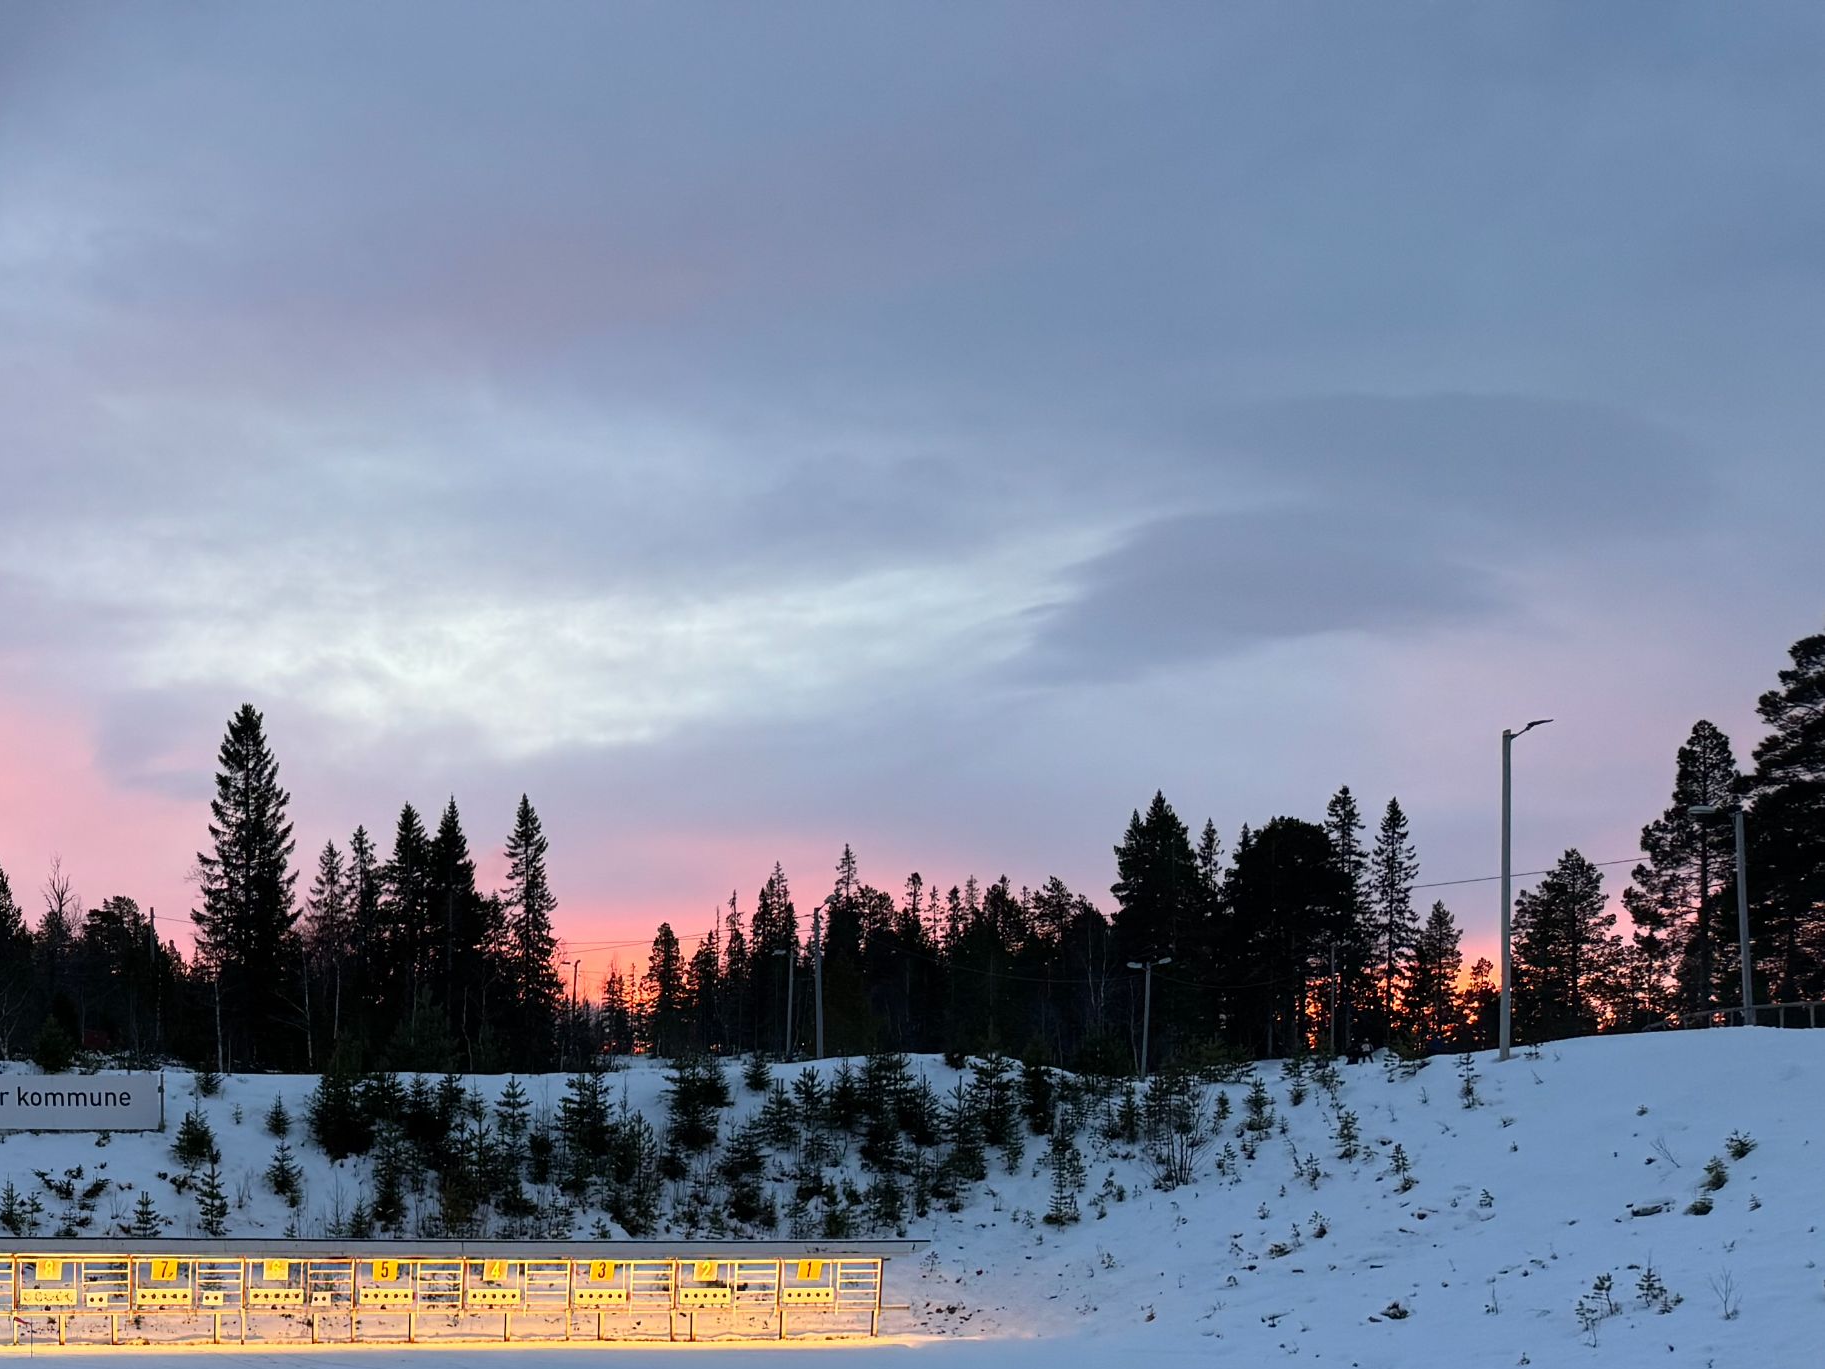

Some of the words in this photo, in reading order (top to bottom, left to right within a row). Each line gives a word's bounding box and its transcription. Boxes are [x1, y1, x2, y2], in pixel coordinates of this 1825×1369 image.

[17, 1086, 132, 1107] kommune
[43, 1261, 55, 1278] 8
[160, 1260, 170, 1278] 7
[380, 1261, 389, 1278] 5
[490, 1261, 501, 1278] 4
[598, 1262, 607, 1279] 3
[701, 1262, 712, 1279] 2
